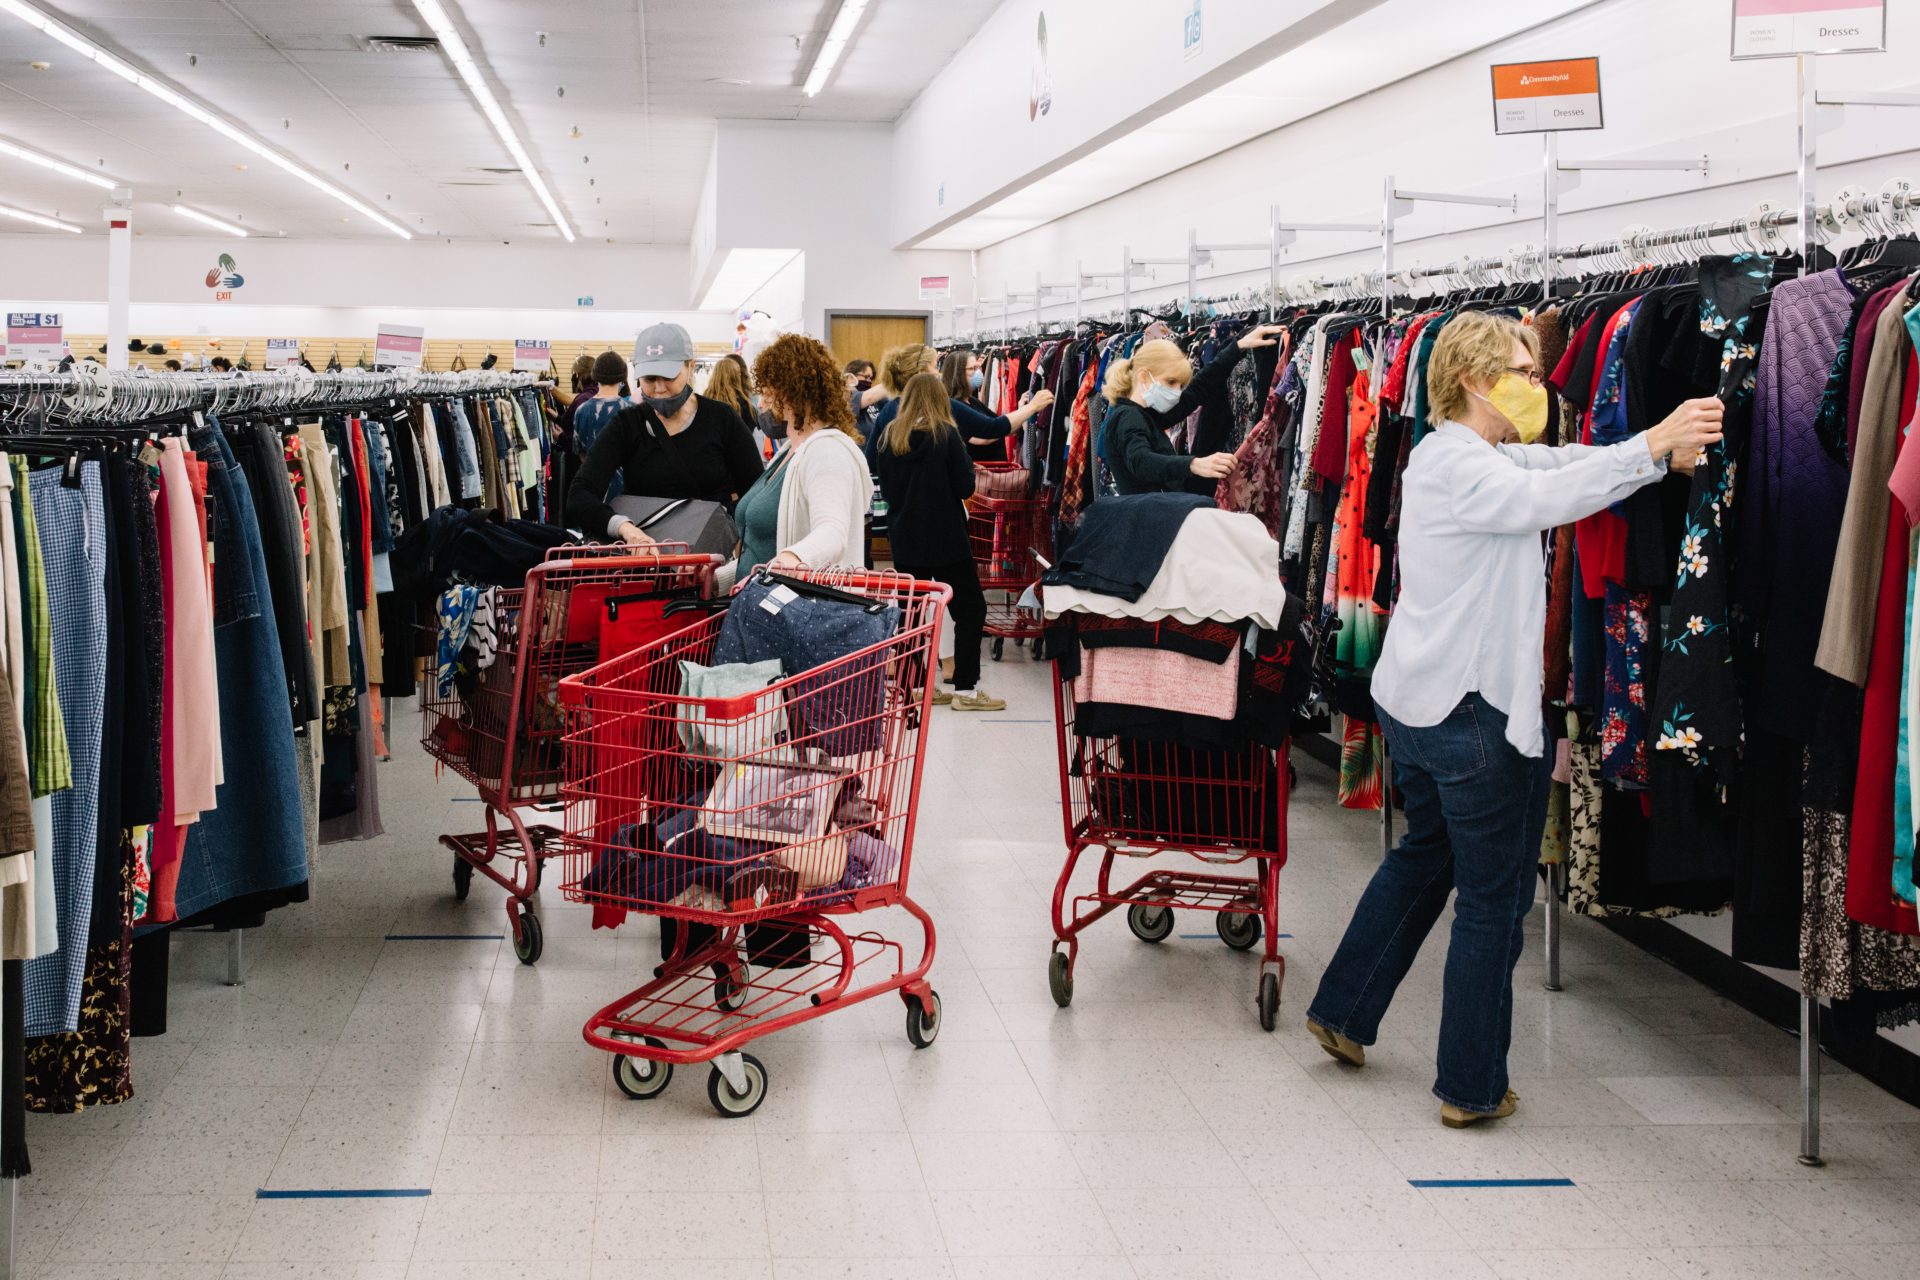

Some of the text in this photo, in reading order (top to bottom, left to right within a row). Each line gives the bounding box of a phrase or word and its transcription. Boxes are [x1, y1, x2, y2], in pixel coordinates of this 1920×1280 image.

[1819, 27, 1859, 37] Dresses
[1528, 73, 1569, 82] CommunityAid
[1553, 109, 1585, 118] Dresses
[1897, 181, 1909, 191] 16
[1838, 191, 1850, 202] 14
[1881, 192, 1891, 206] 16
[216, 291, 232, 300] EXIT
[44, 313, 58, 326] $1
[539, 340, 548, 348] $1
[33, 363, 42, 371] 16
[84, 364, 98, 376] 14
[278, 368, 288, 376] 12
[99, 384, 108, 398] 14
